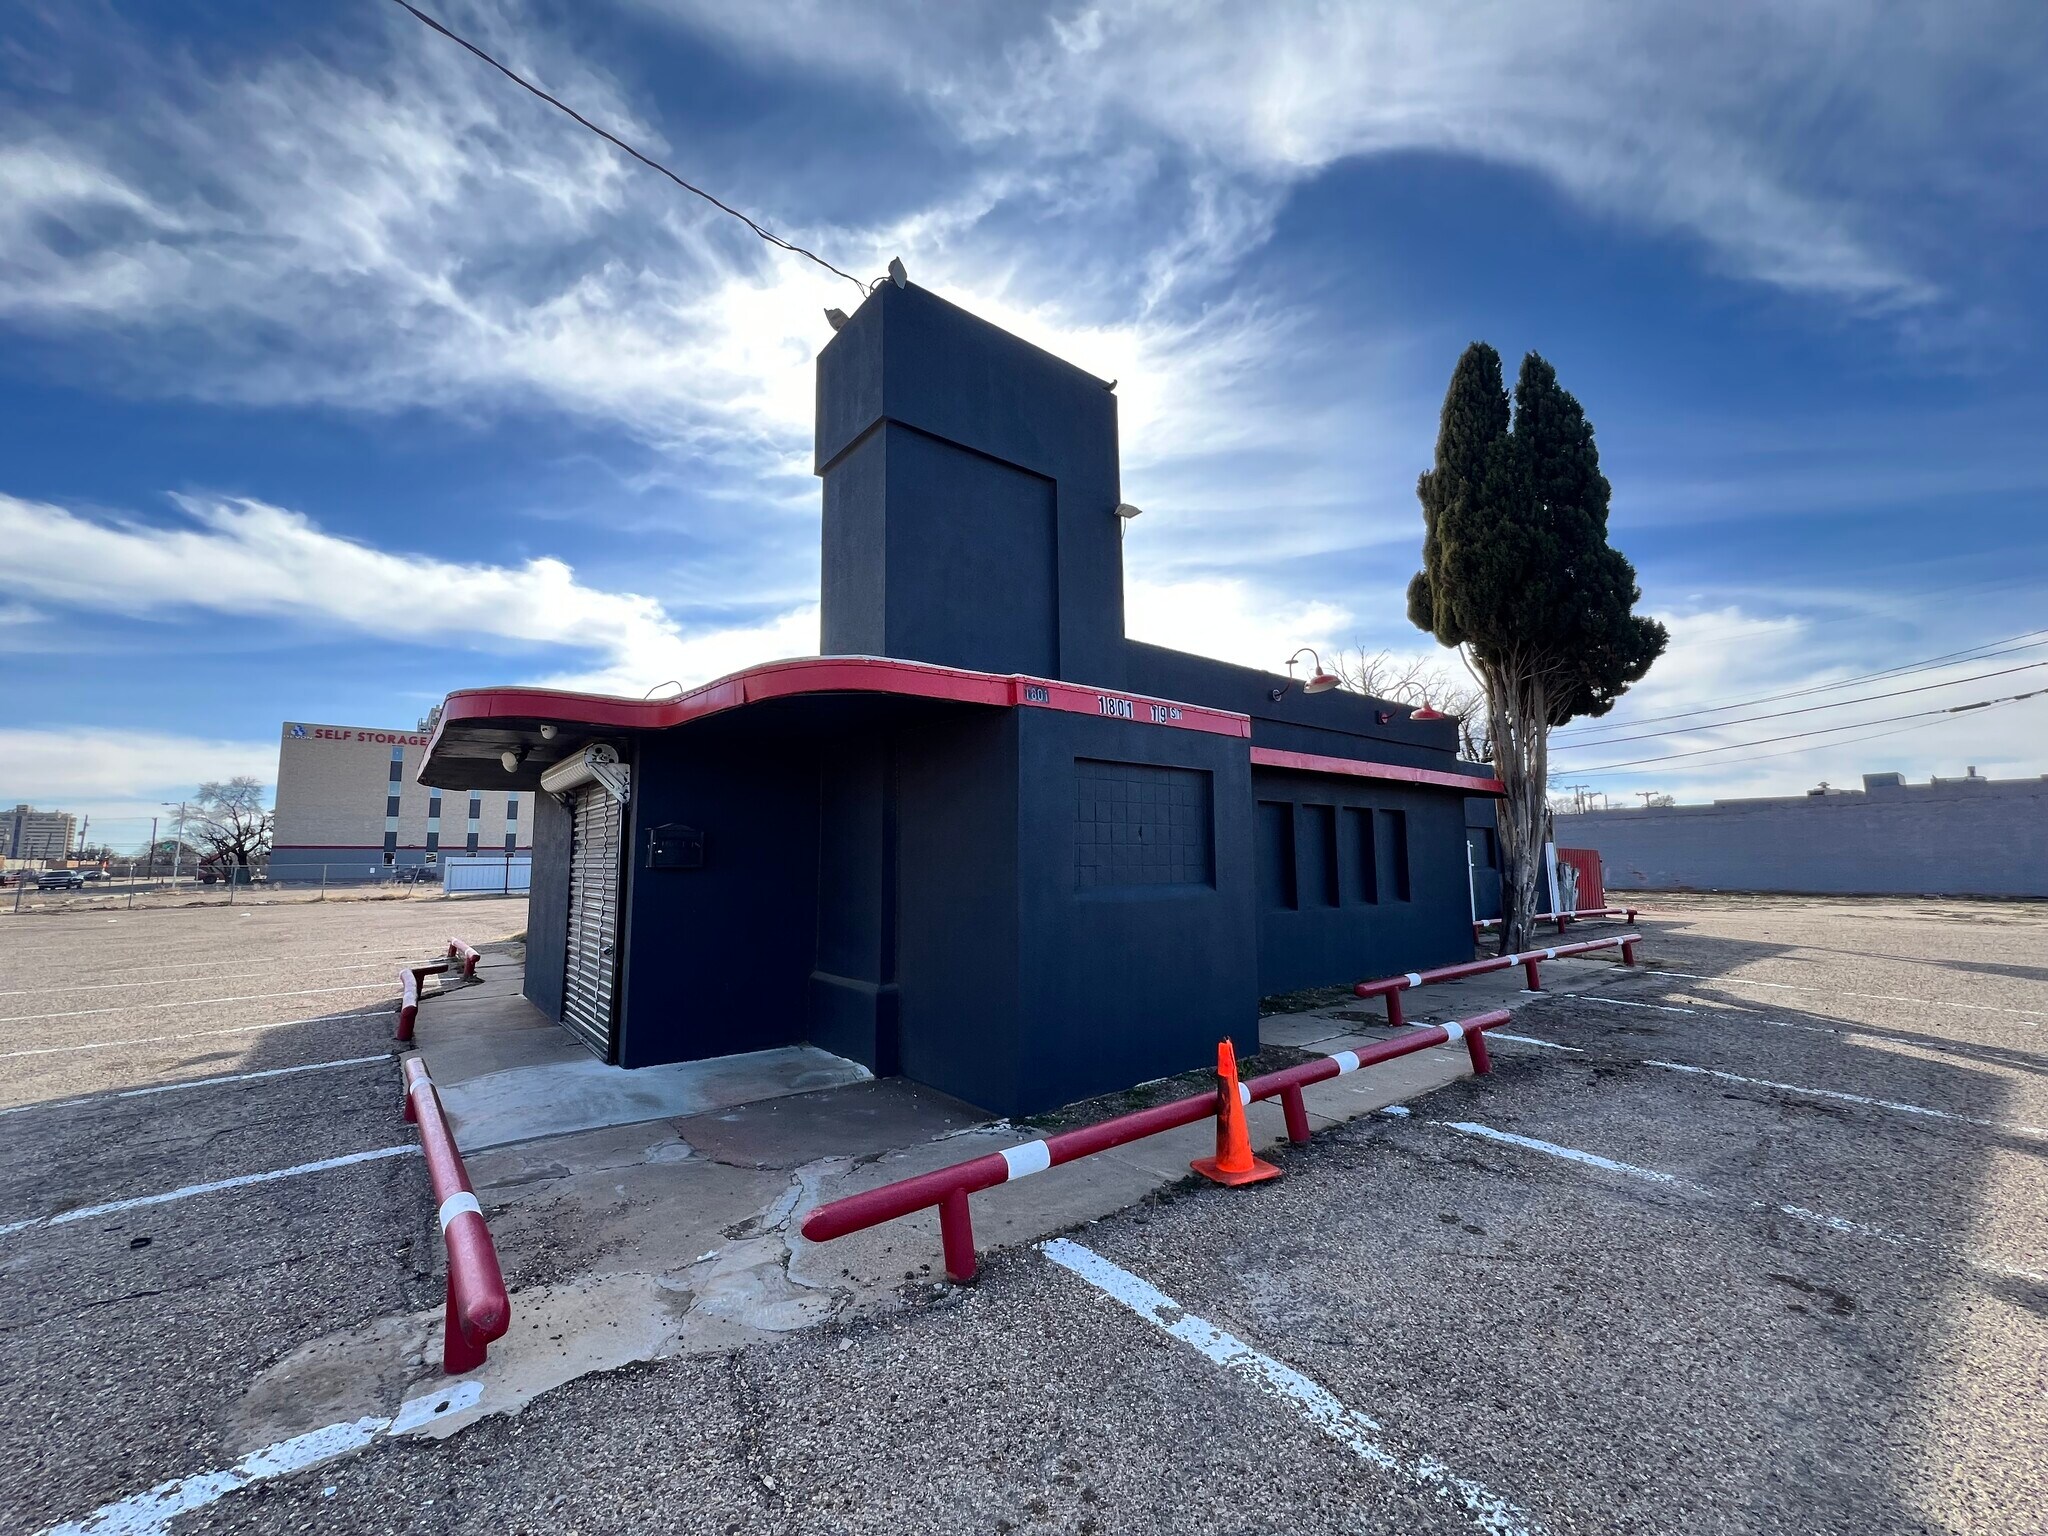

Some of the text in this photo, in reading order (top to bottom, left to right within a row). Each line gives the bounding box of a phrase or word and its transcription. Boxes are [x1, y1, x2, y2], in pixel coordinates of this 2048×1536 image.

[1025, 687, 1048, 702] 1801
[1098, 696, 1182, 723] 1801 19 ST
[314, 728, 427, 746] SELF STORAGE
